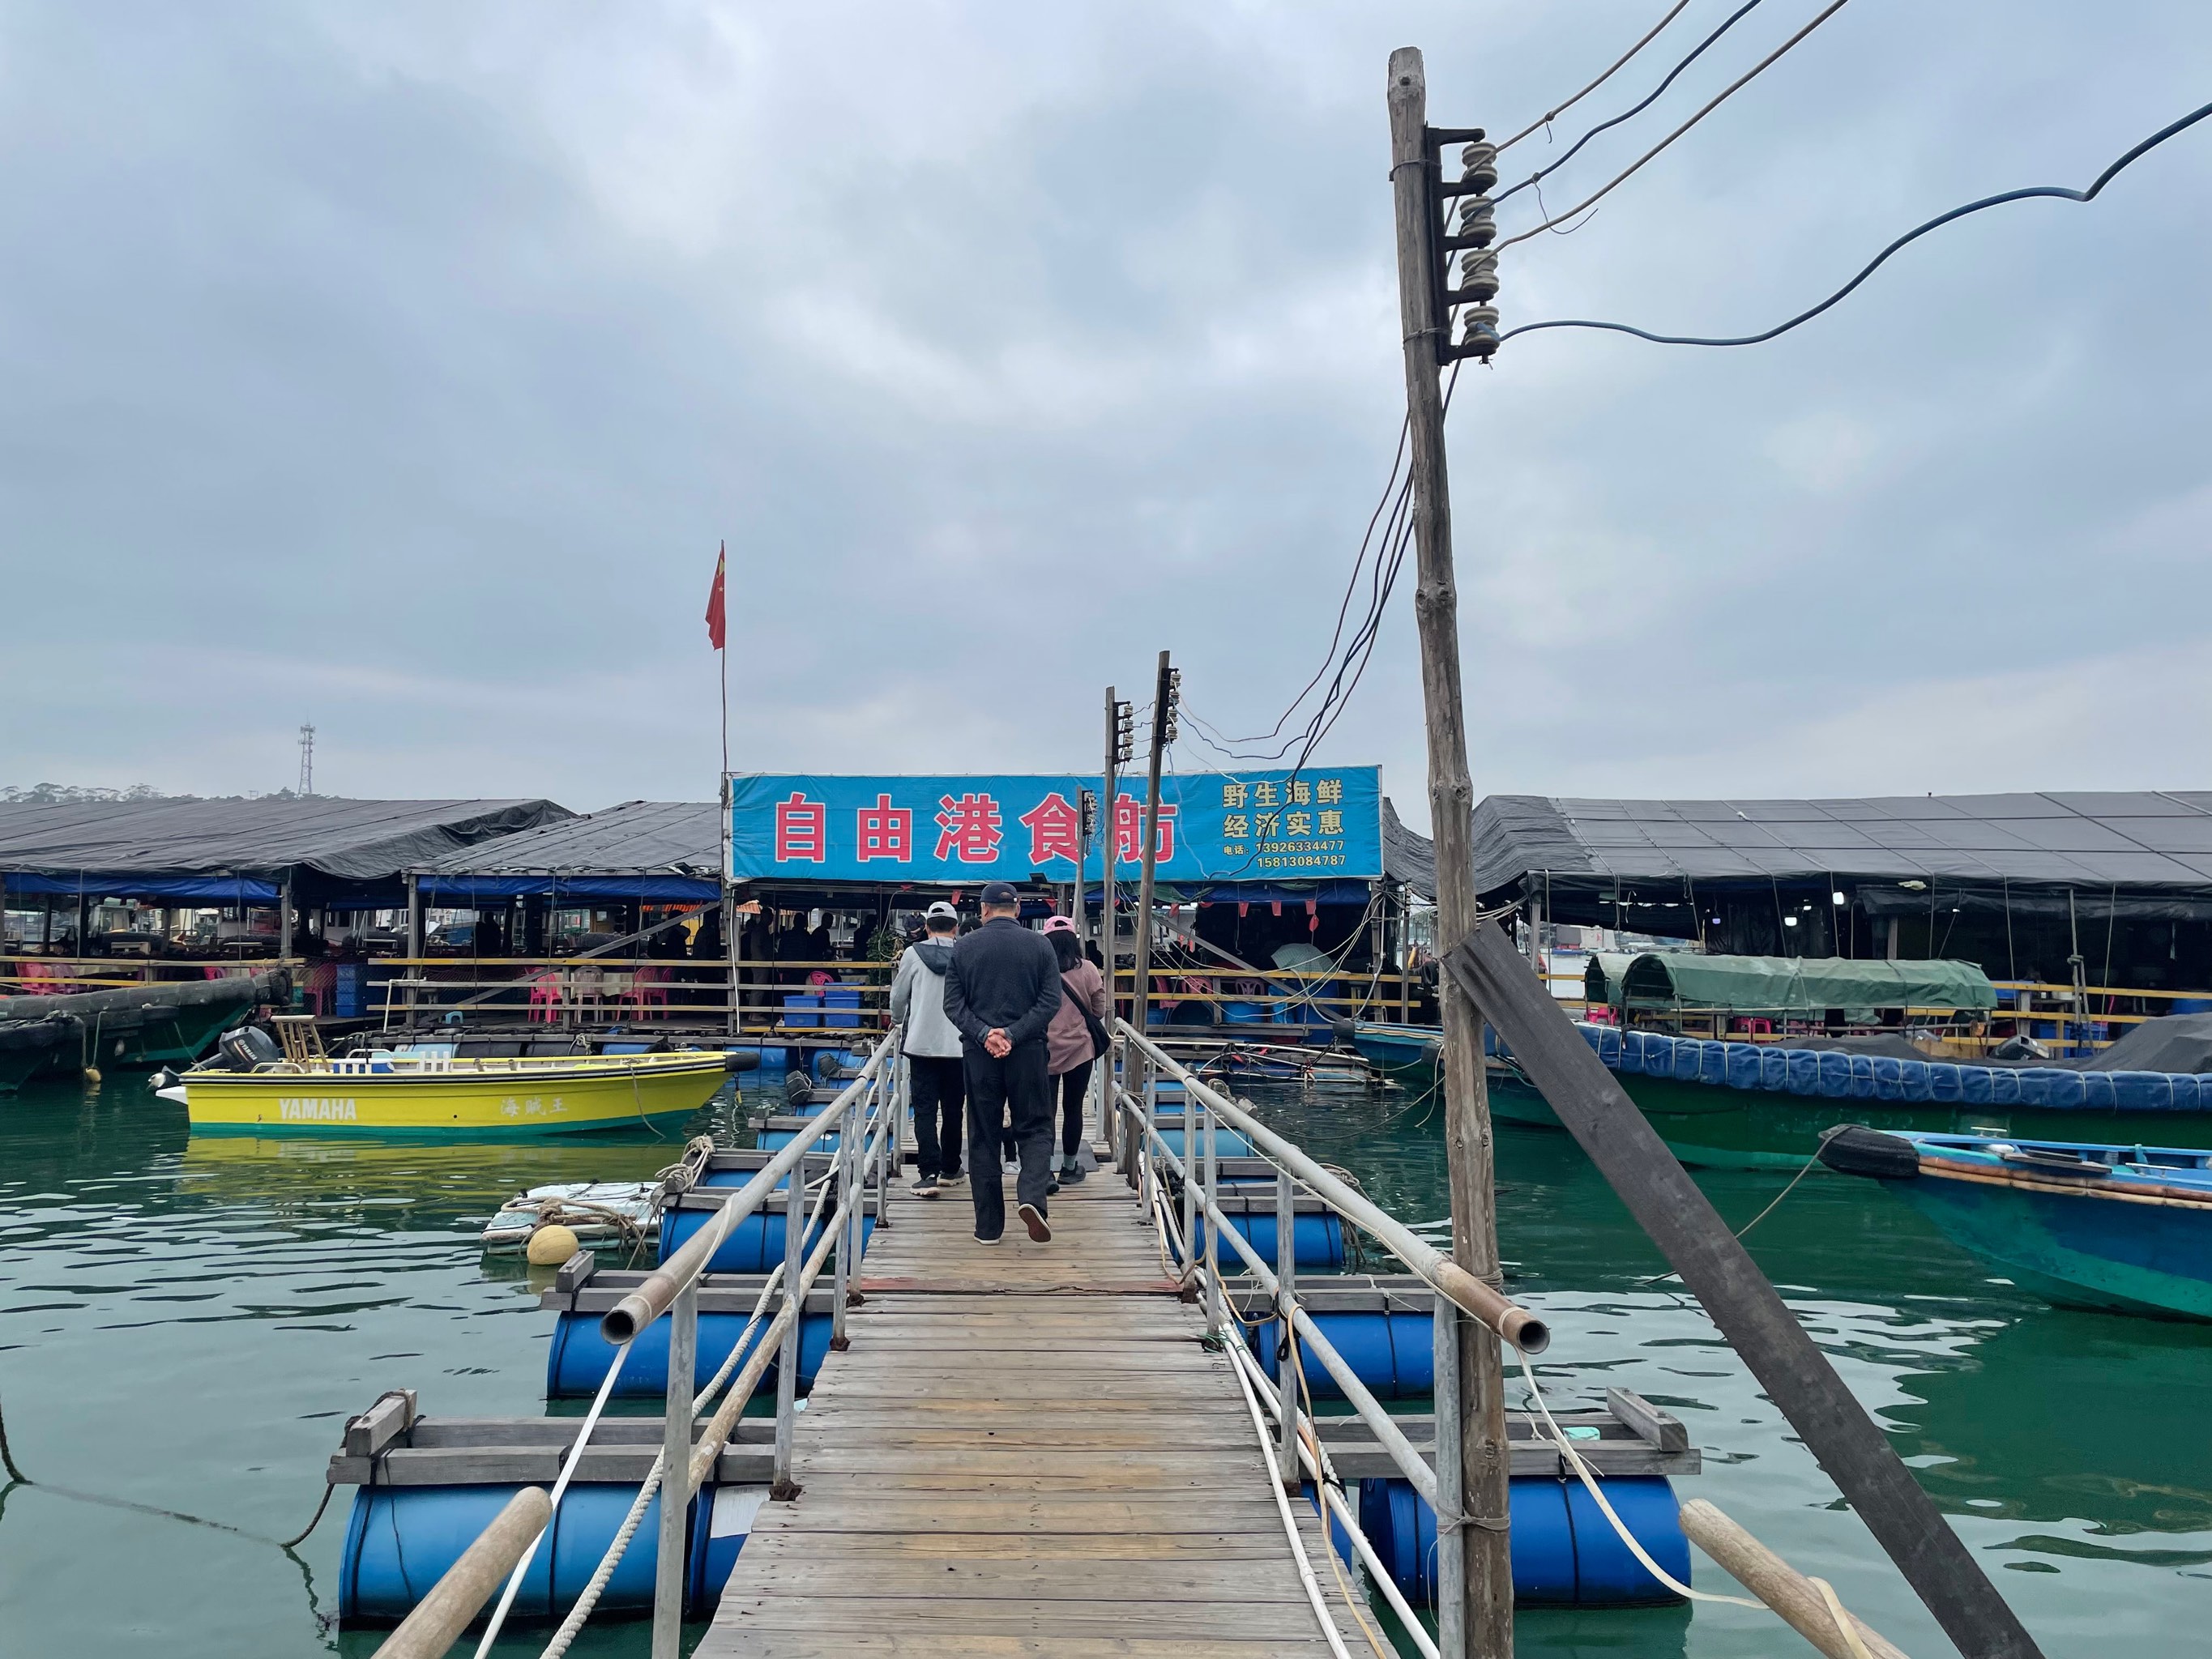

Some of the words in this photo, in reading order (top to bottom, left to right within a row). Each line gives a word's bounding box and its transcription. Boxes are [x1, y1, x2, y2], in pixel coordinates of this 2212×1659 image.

[1223, 778, 1343, 809] 野生海鲜
[1223, 809, 1345, 839] 经济实惠
[1256, 840, 1345, 854] 13926334477
[1257, 855, 1347, 868] 15813084787
[278, 1098, 357, 1120] YAMAHA
